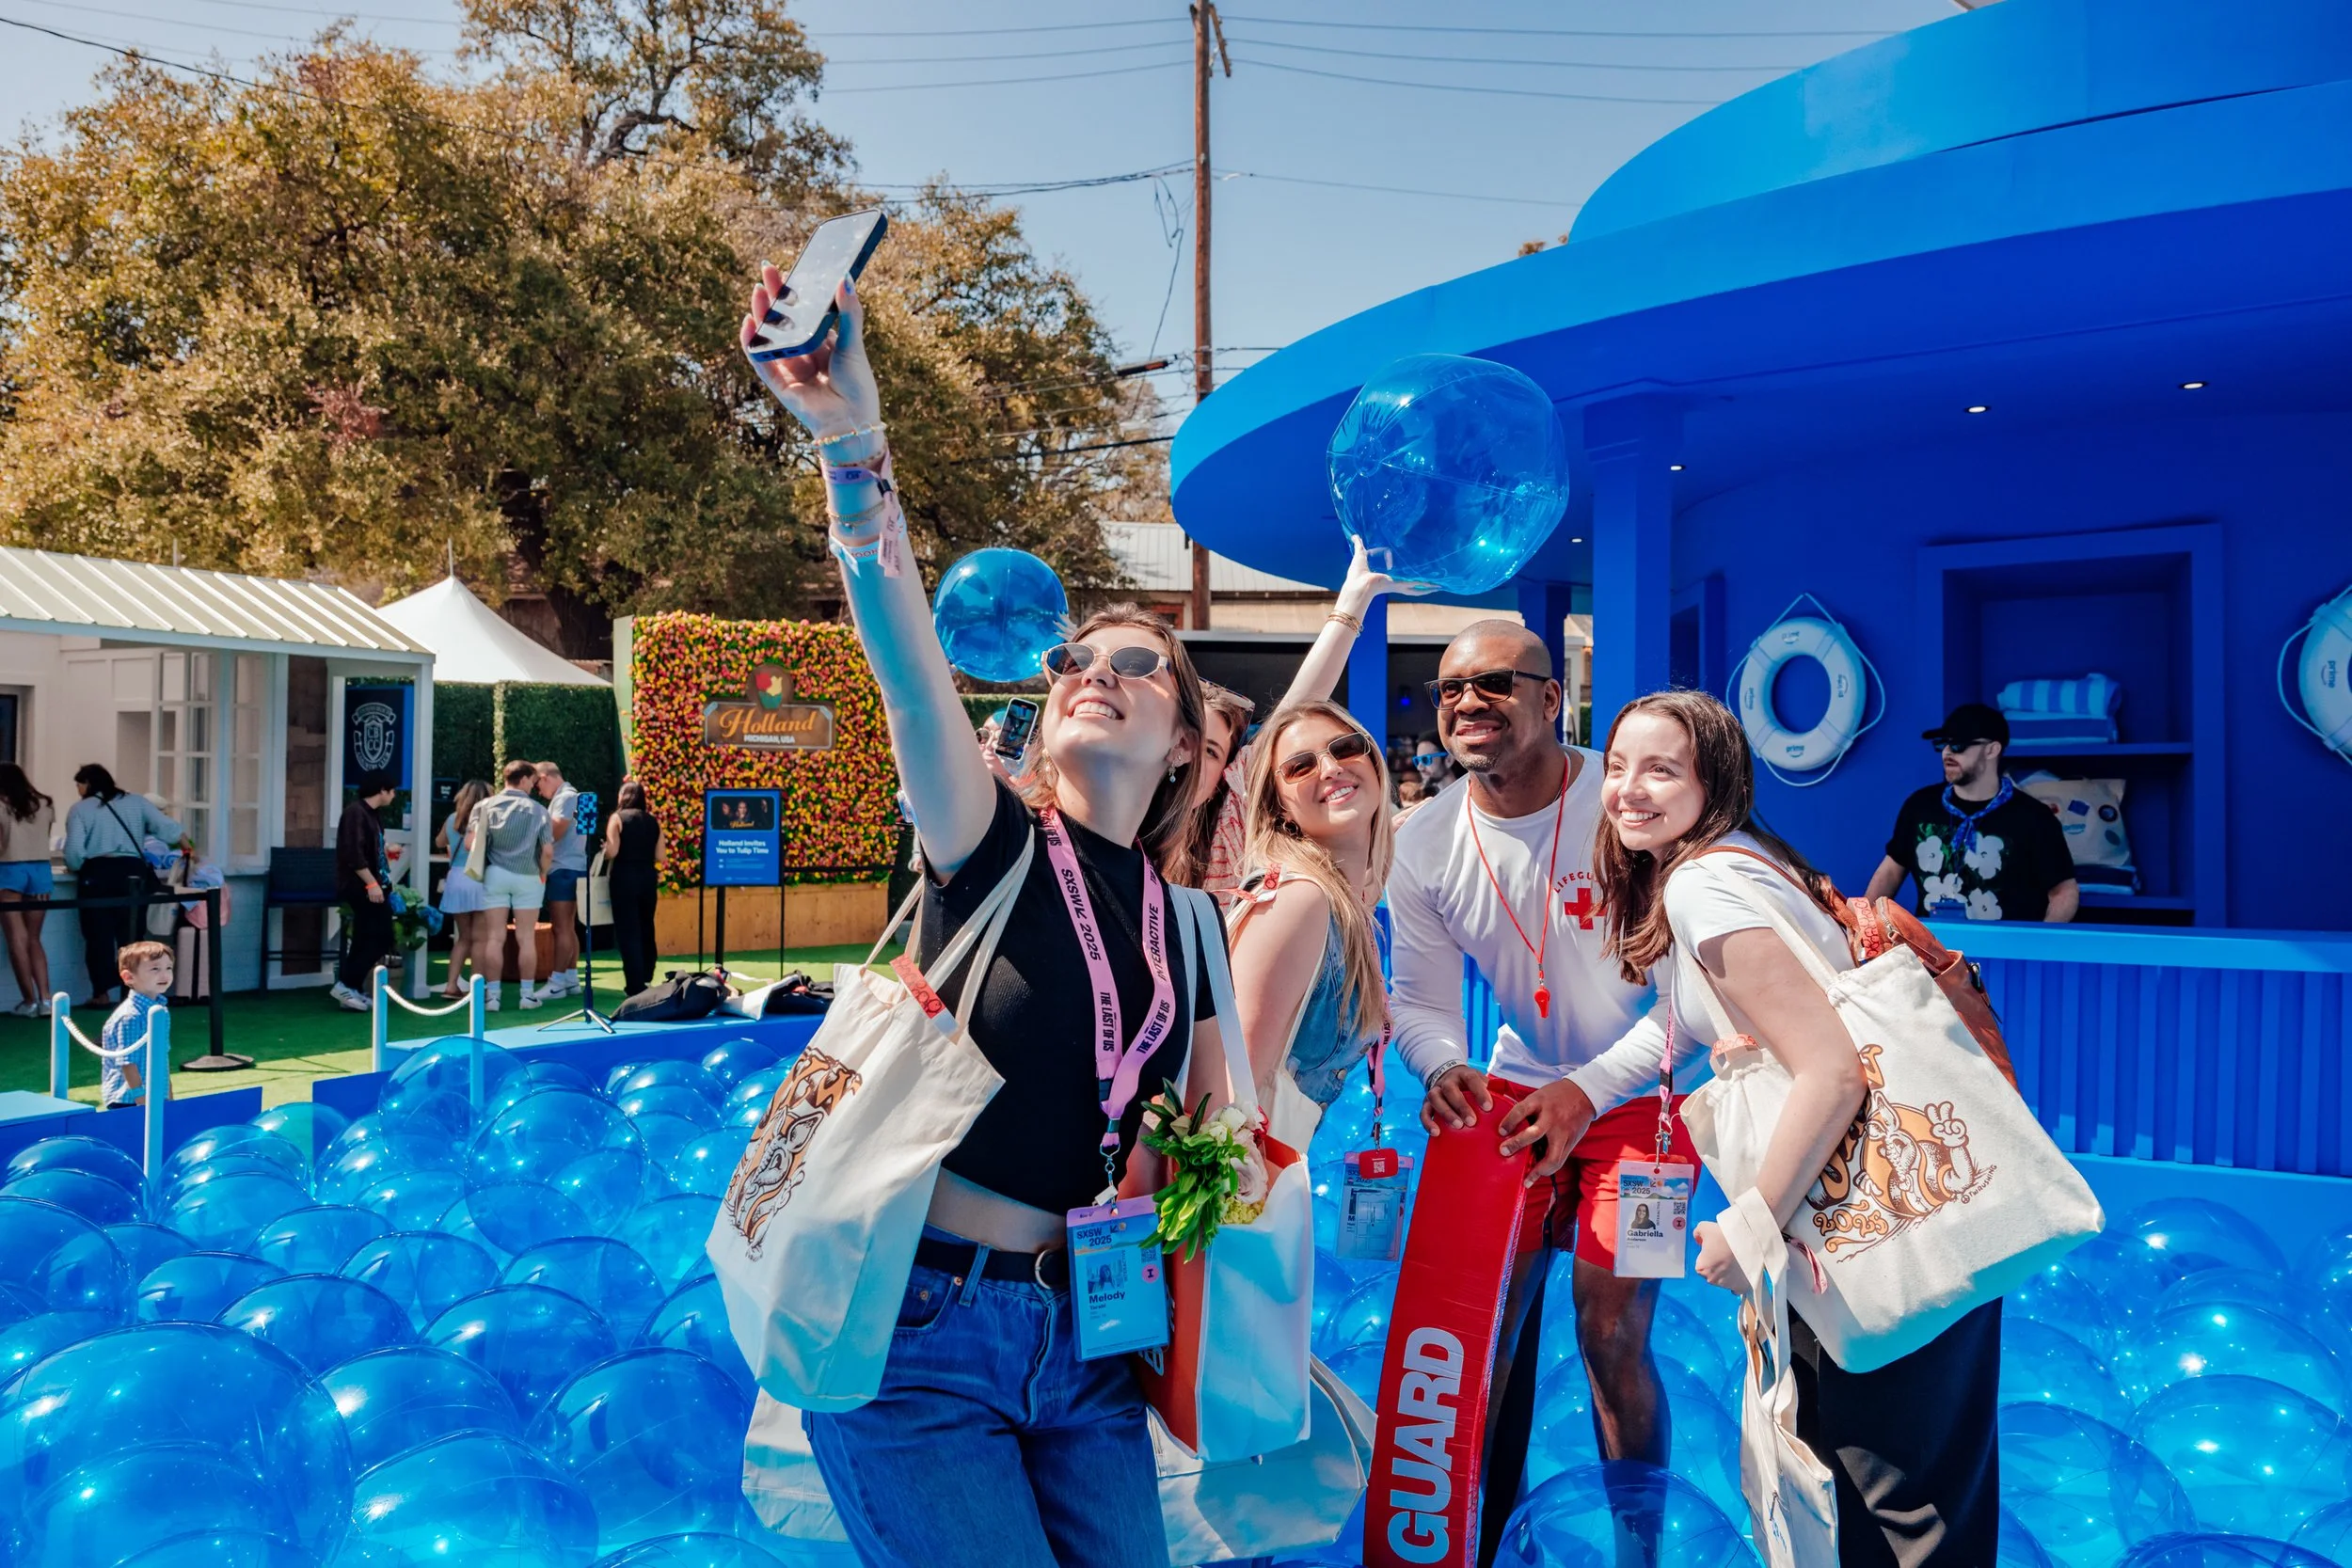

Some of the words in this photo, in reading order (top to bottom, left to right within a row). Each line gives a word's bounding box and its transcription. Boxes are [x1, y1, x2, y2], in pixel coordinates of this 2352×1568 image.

[2328, 660, 2336, 689] prime
[719, 707, 818, 738] Holland
[1786, 745, 1804, 753] prime
[1047, 836, 1062, 847] US
[737, 847, 753, 855] Tulip
[1061, 868, 1084, 907] SXSW
[1080, 922, 1102, 961] 2025
[1149, 903, 1168, 982] INTERACTIVE
[1100, 991, 1112, 1006] THE
[1159, 999, 1170, 1014] US
[1102, 1006, 1114, 1029] LAST
[1155, 1009, 1168, 1023] OF
[1103, 1029, 1114, 1040] OF
[1145, 1021, 1164, 1042] LAST
[1103, 1039, 1115, 1052] US
[1136, 1038, 1153, 1053] THE
[1813, 1209, 1889, 1238] 2025
[1076, 1227, 1103, 1240] SXSW
[1089, 1234, 1112, 1247] 2025
[1627, 1229, 1663, 1238] Gabriella
[1147, 1268, 1154, 1278] I
[1089, 1291, 1125, 1305] Melody
[1388, 1327, 1464, 1564] GUARD
